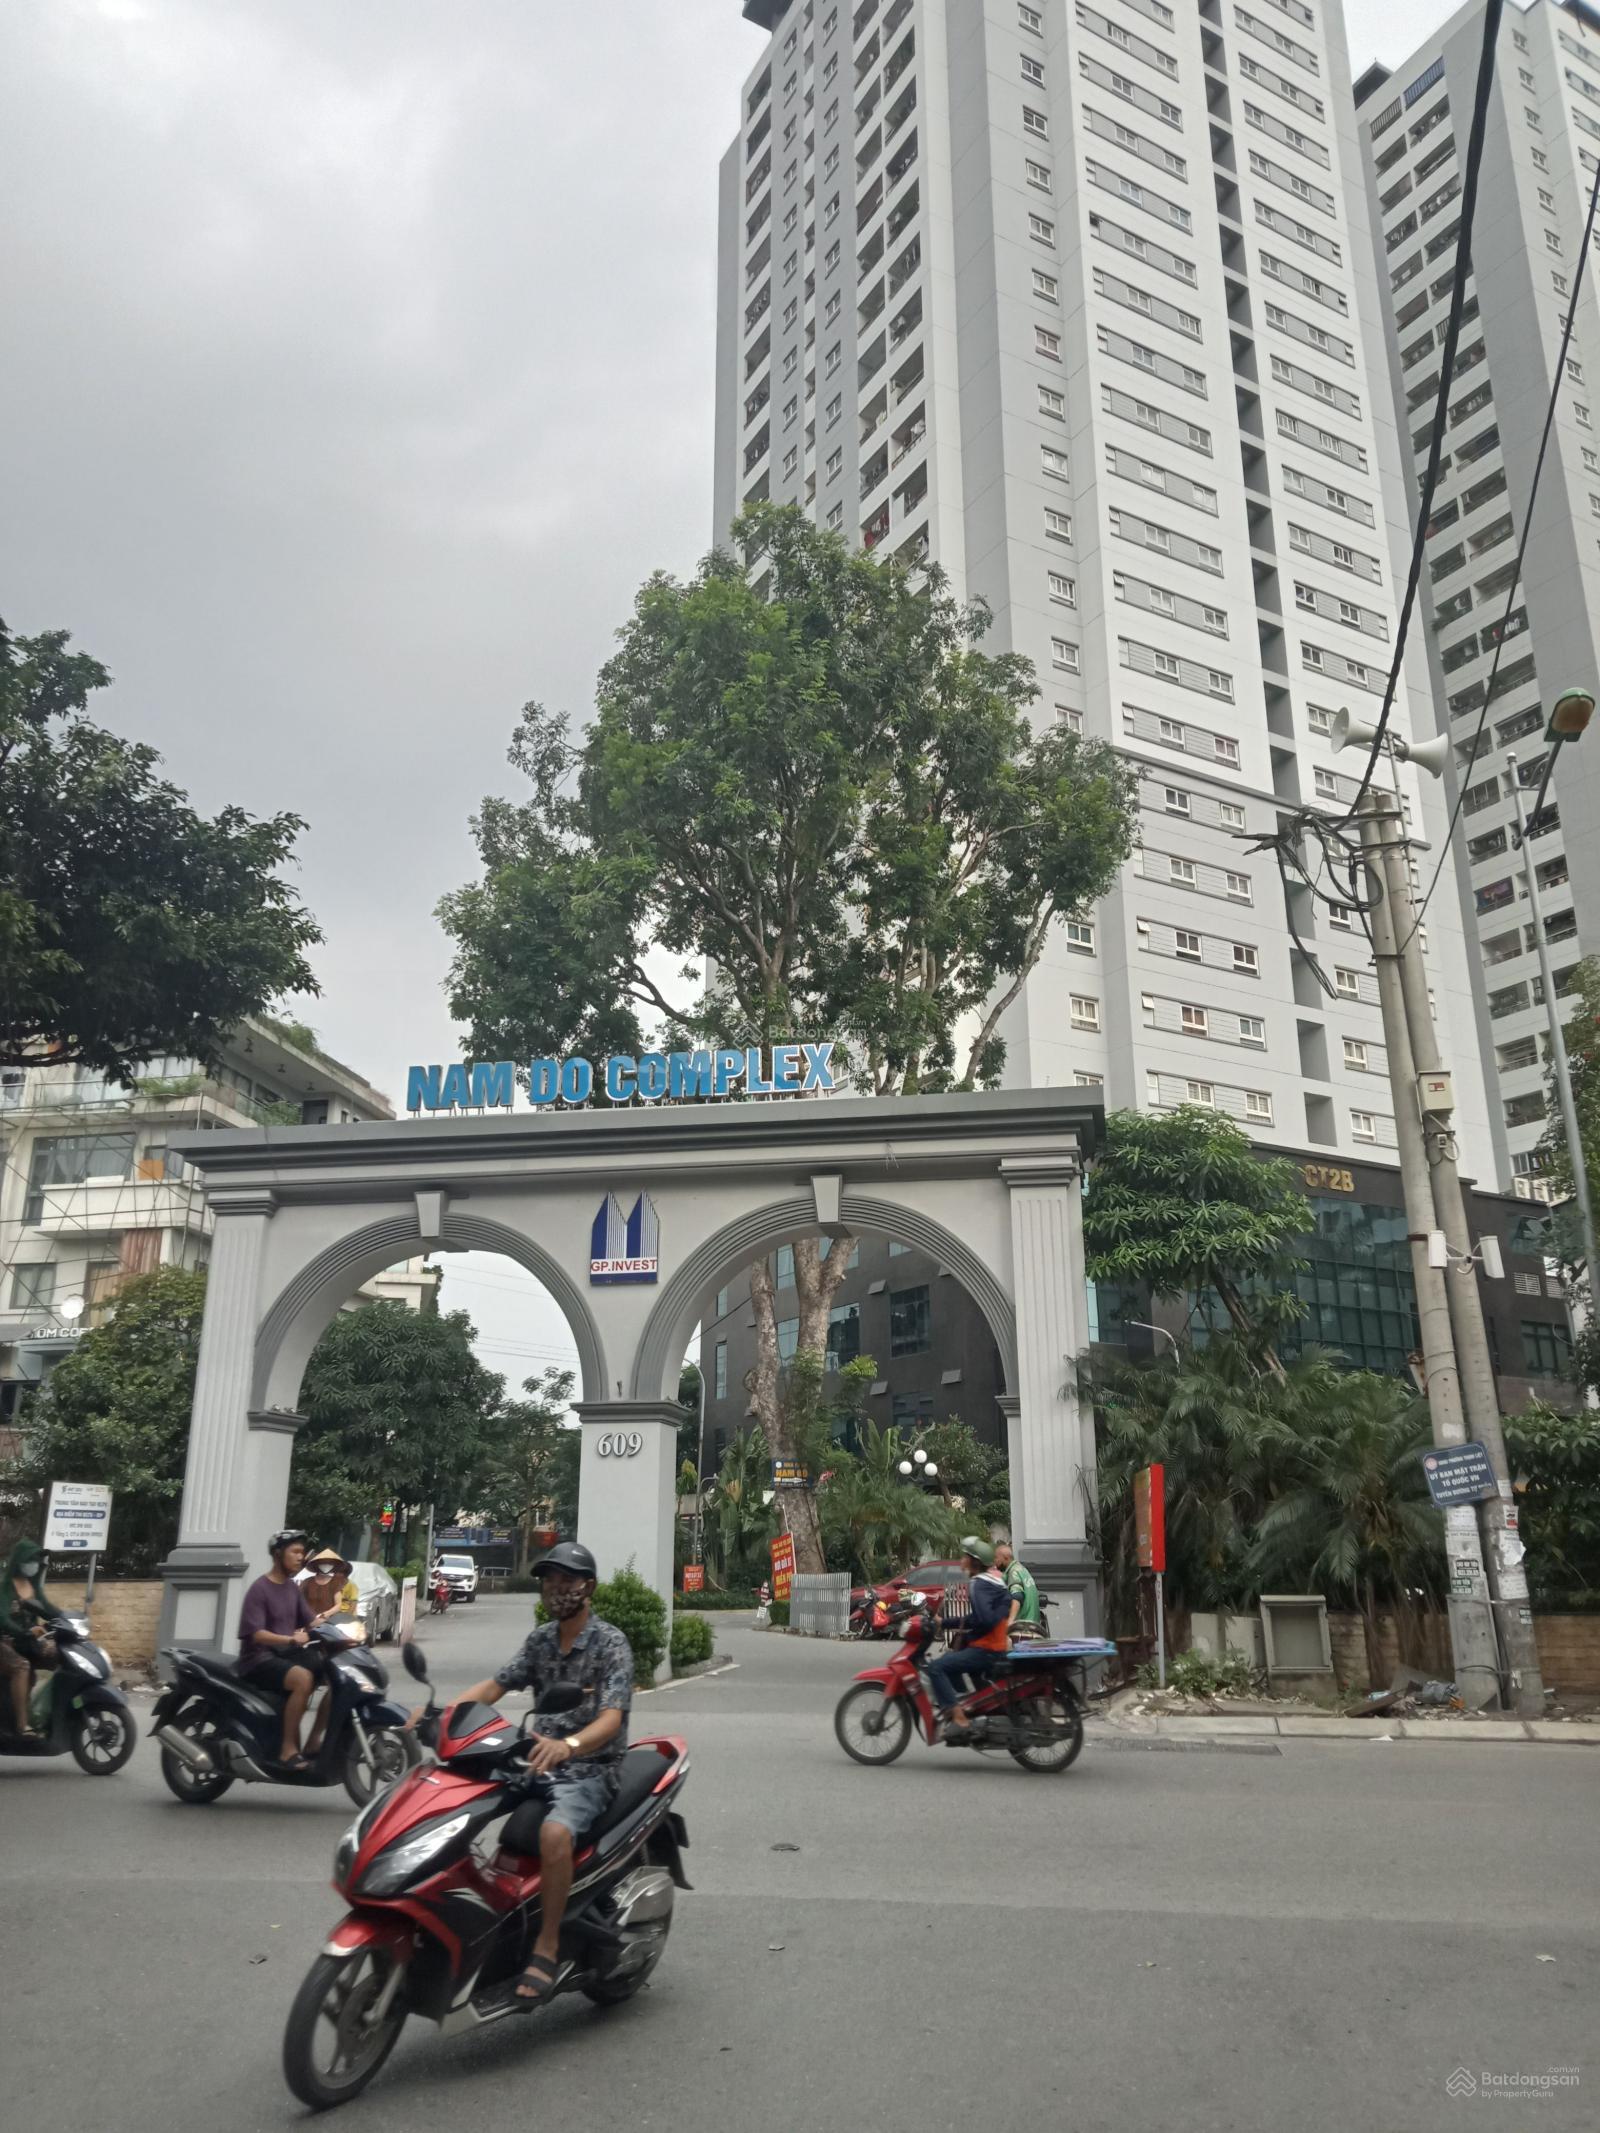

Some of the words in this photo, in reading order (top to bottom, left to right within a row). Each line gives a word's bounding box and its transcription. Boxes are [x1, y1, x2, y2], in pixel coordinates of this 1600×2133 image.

[408, 1061, 515, 1111] NAM
[530, 1057, 593, 1103] DO
[605, 1043, 836, 1101] COMPLEX
[1305, 1164, 1355, 1191] CT2B
[590, 1258, 658, 1273] GP.INVEST
[31, 1328, 58, 1339] OM
[598, 1432, 643, 1457] 609
